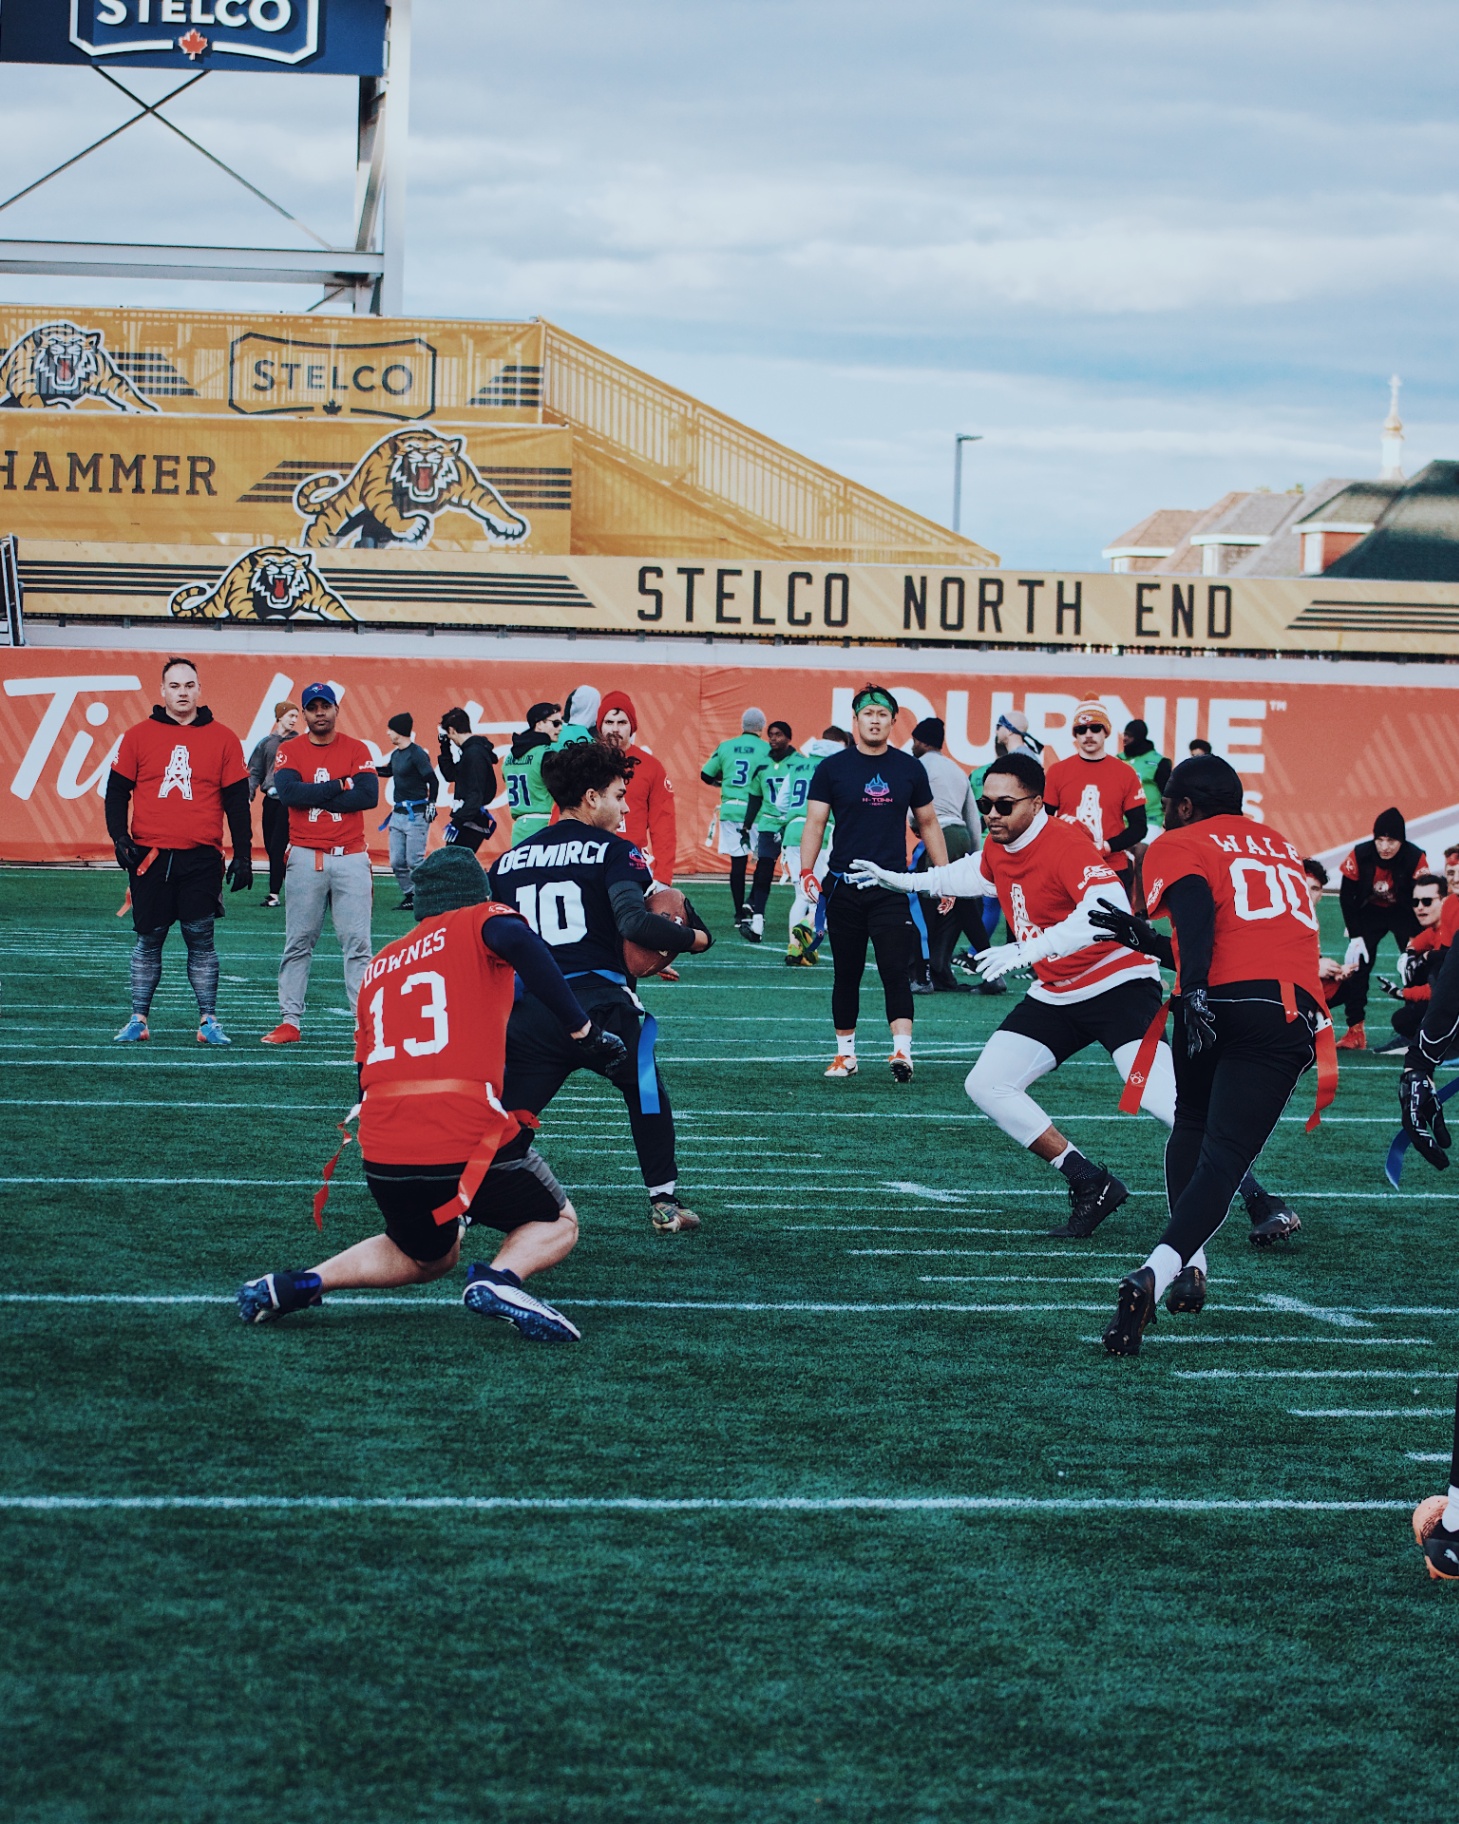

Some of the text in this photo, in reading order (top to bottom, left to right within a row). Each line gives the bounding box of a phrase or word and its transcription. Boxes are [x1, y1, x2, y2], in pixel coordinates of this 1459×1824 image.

[96, 0, 292, 33] STELCO
[252, 358, 413, 397] STELCO
[637, 566, 1233, 639] STELCO NORTH END
[507, 774, 531, 807] 31
[723, 760, 748, 785] 3
[515, 880, 587, 946] 10
[1229, 857, 1319, 932] 00
[364, 927, 447, 989] DOWNES
[366, 970, 449, 1066] 13
